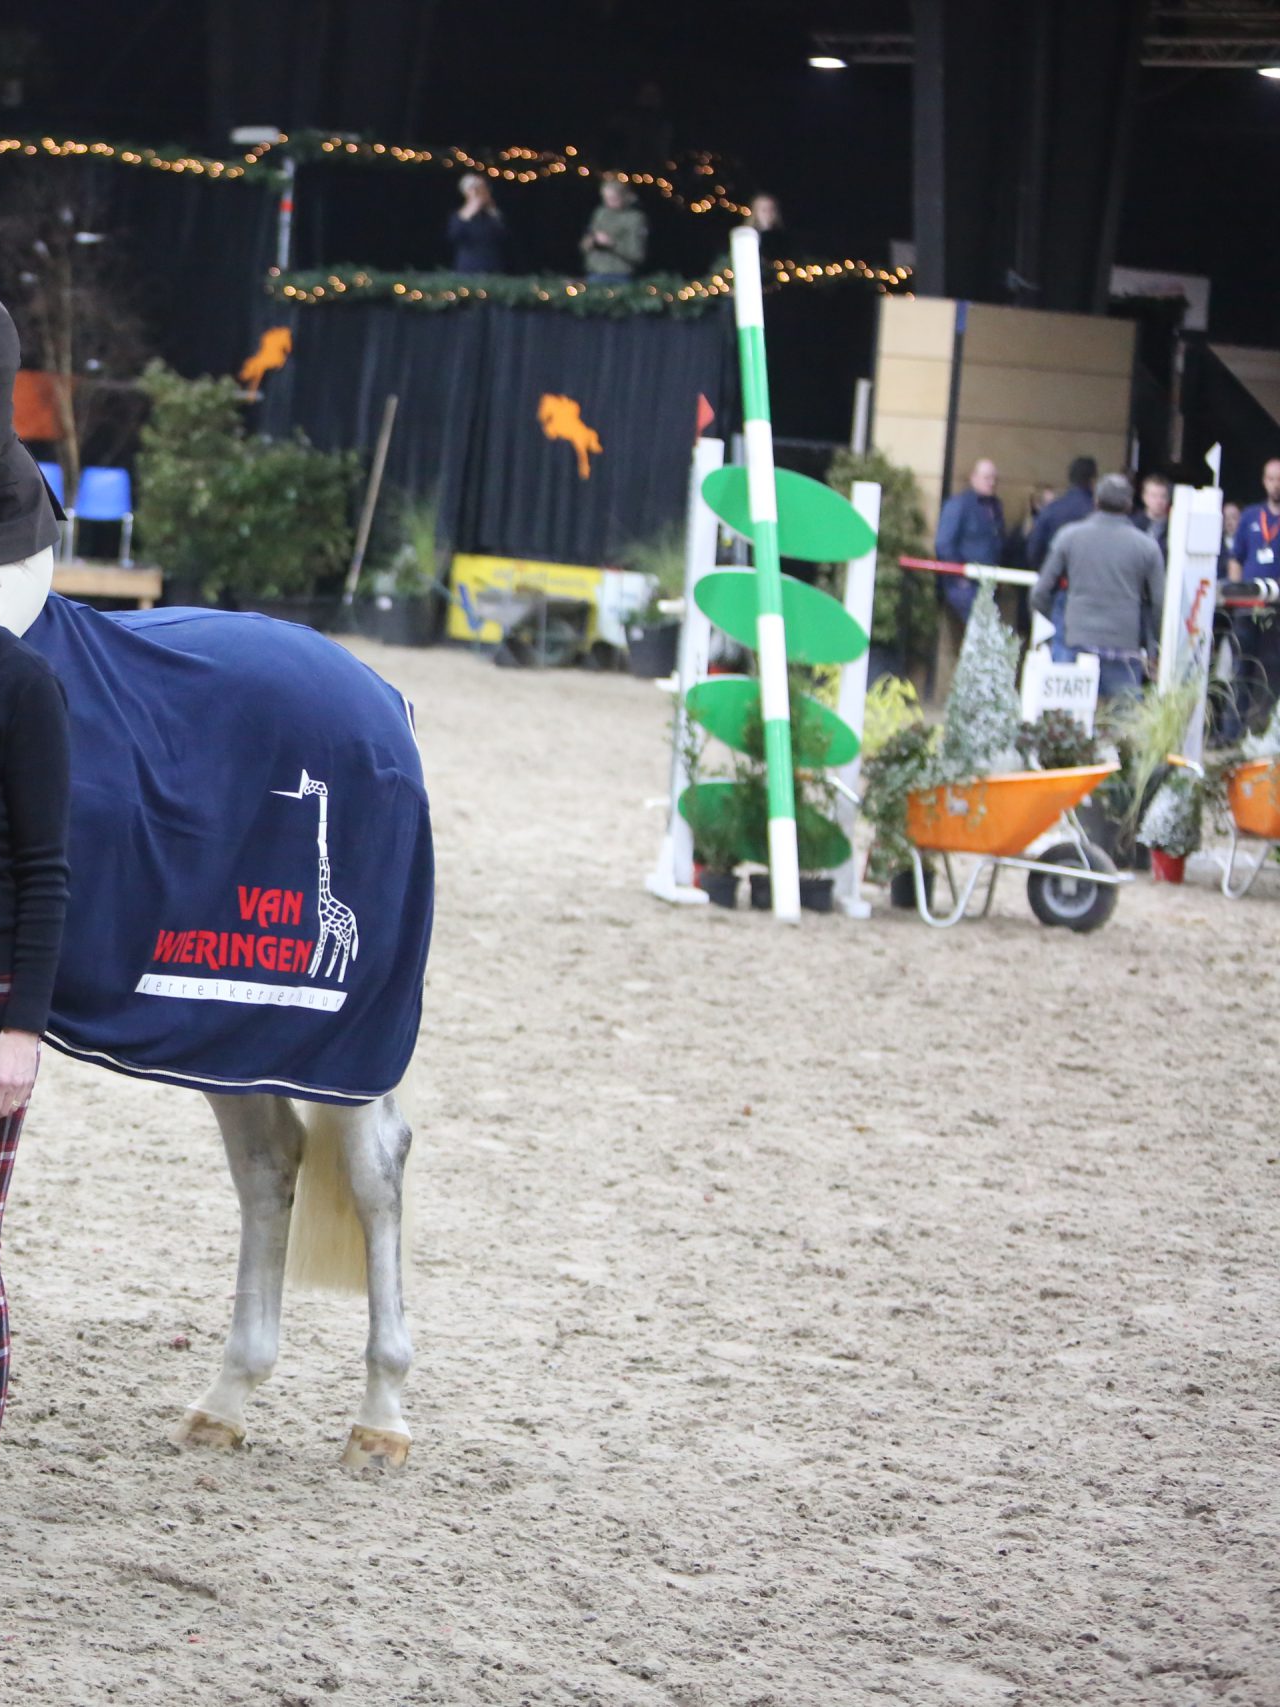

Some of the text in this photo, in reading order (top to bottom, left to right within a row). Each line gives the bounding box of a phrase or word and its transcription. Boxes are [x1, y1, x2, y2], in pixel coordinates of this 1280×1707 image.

[1042, 677, 1093, 699] START
[238, 885, 304, 929] VAN
[153, 929, 314, 974] WIERINGEN
